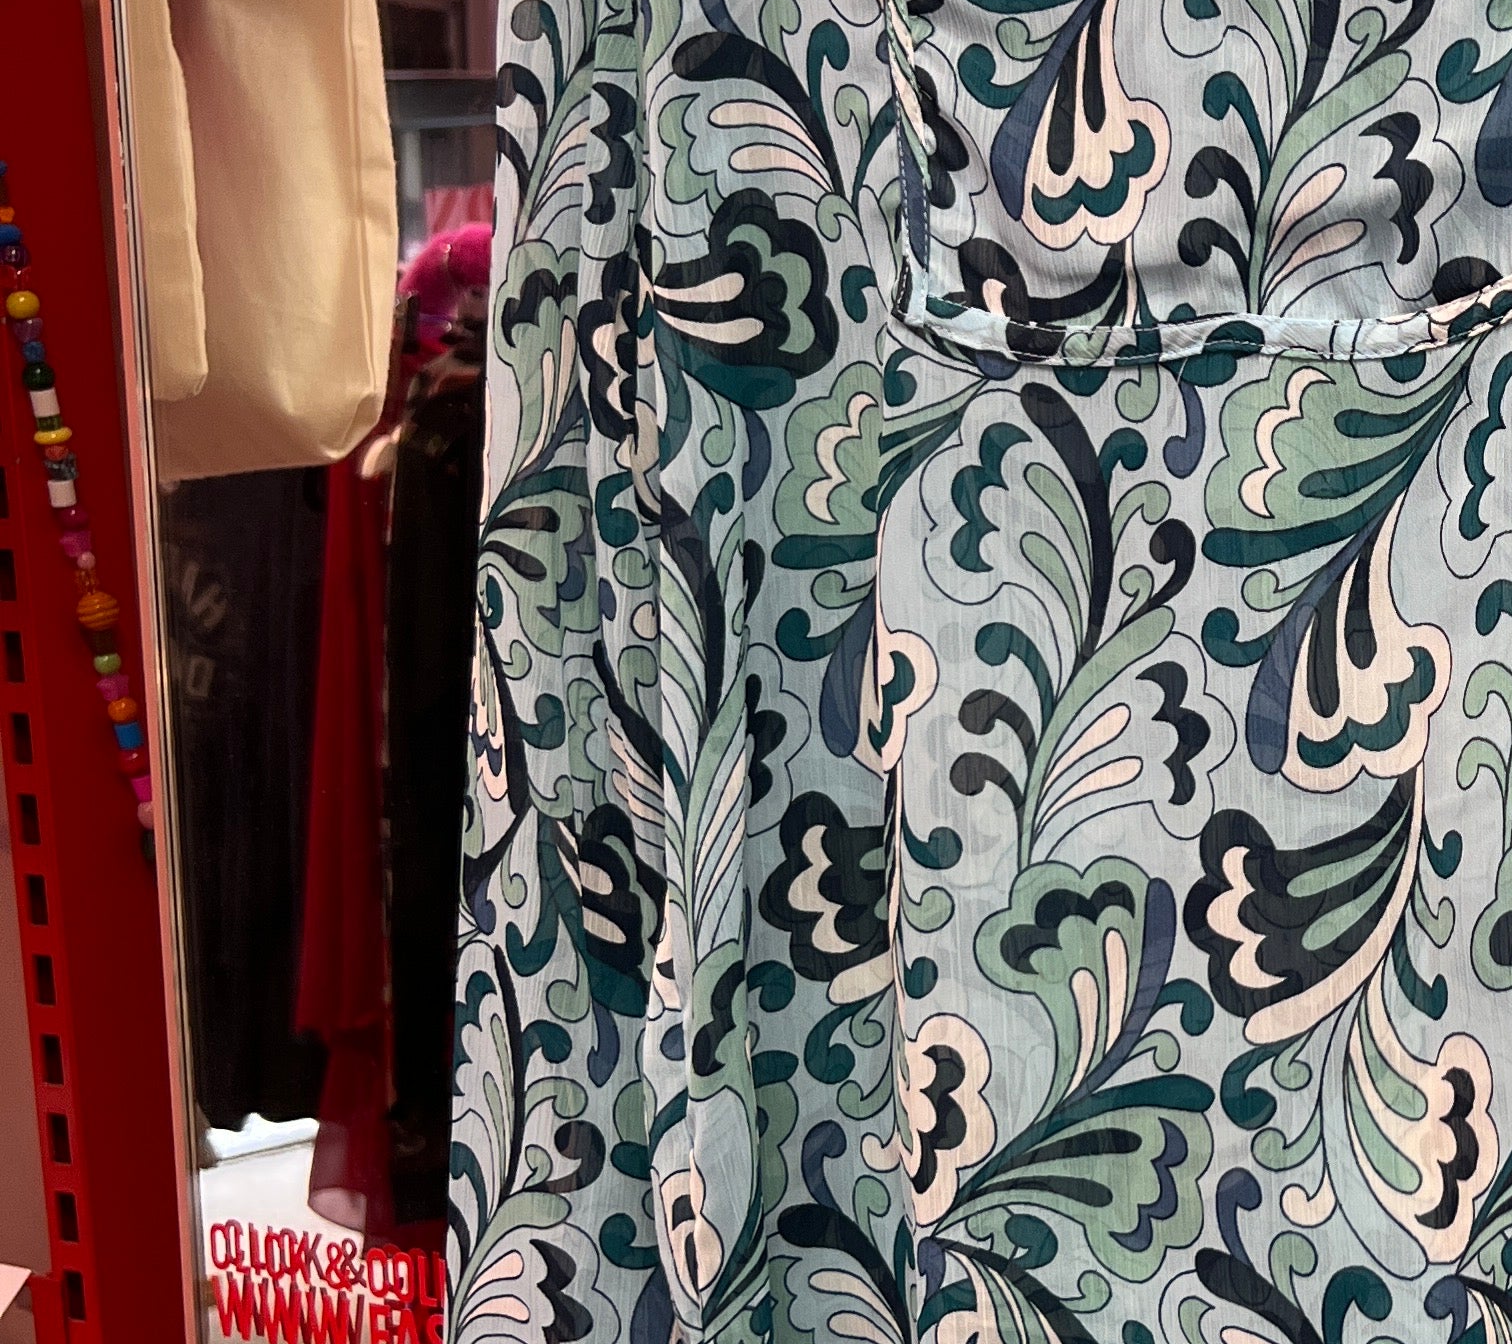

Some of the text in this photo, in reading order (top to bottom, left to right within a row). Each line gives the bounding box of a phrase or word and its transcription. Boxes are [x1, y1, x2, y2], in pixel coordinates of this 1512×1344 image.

[210, 1222, 445, 1308] CLICK & COL
